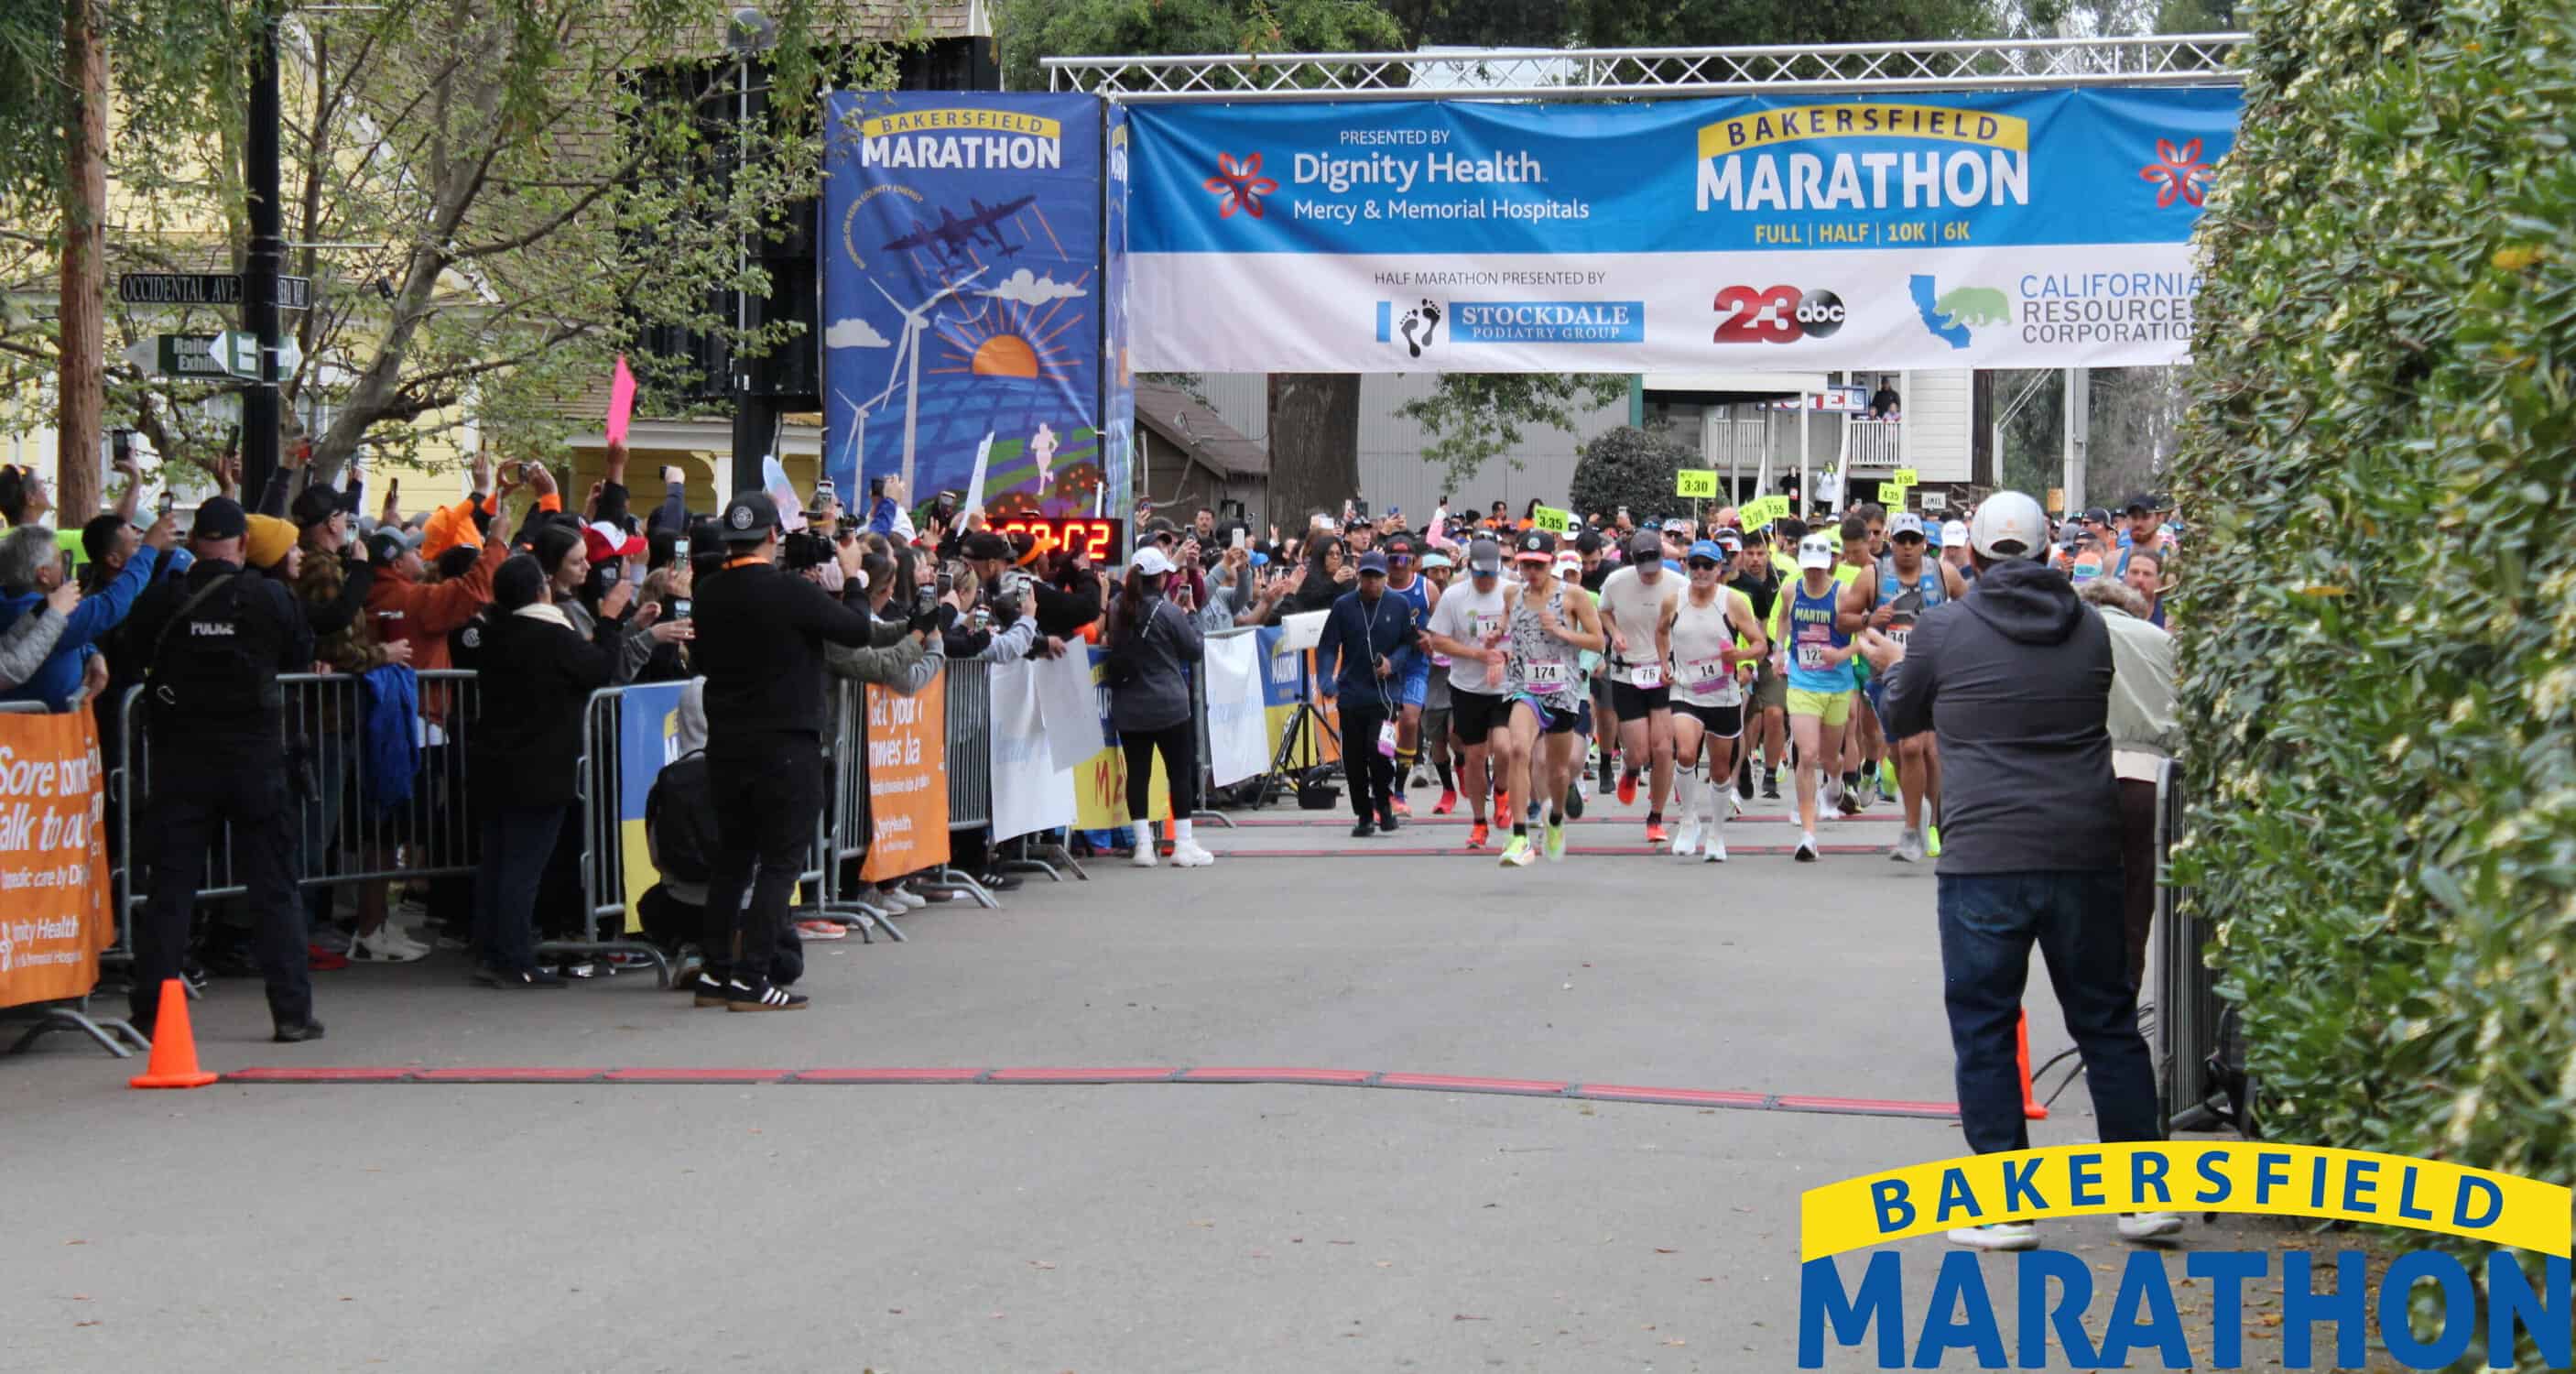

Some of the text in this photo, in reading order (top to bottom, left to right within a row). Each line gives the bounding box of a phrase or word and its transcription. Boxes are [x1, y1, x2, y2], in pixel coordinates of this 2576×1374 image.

[881, 111, 1043, 134] BAKERSFIELD
[1727, 108, 1999, 147] BAKERSFIELD
[1340, 130, 1450, 145] PRESENTED BY
[861, 136, 1060, 169] MARATHON
[1294, 150, 1543, 192] Dignity Health
[1697, 148, 2029, 212] MARATHON
[1294, 199, 1589, 224] Mercy & Memorial Hospitals
[1755, 221, 1970, 244] FULL HALF 10K 6K
[122, 276, 206, 301] OCCIDENTAL
[1375, 271, 1605, 286] HALF MARATHON PRESENTED BY
[2020, 273, 2203, 299] CALIFORNIA
[1462, 305, 1630, 325] STOCKDALE
[1712, 284, 1845, 344] 23 abc
[1473, 326, 1620, 339] PODIATRY GROUP
[2023, 322, 2197, 344] CORPORATIO
[1685, 480, 1708, 492] 3:30
[1539, 516, 1562, 529] 3:35
[1794, 607, 1831, 624] MARTIN
[1534, 666, 1556, 679] 174
[1641, 669, 1656, 680] 76
[1701, 665, 1715, 677] 14
[871, 689, 887, 725] Get
[0, 802, 37, 851] alk
[37, 916, 79, 938] Health
